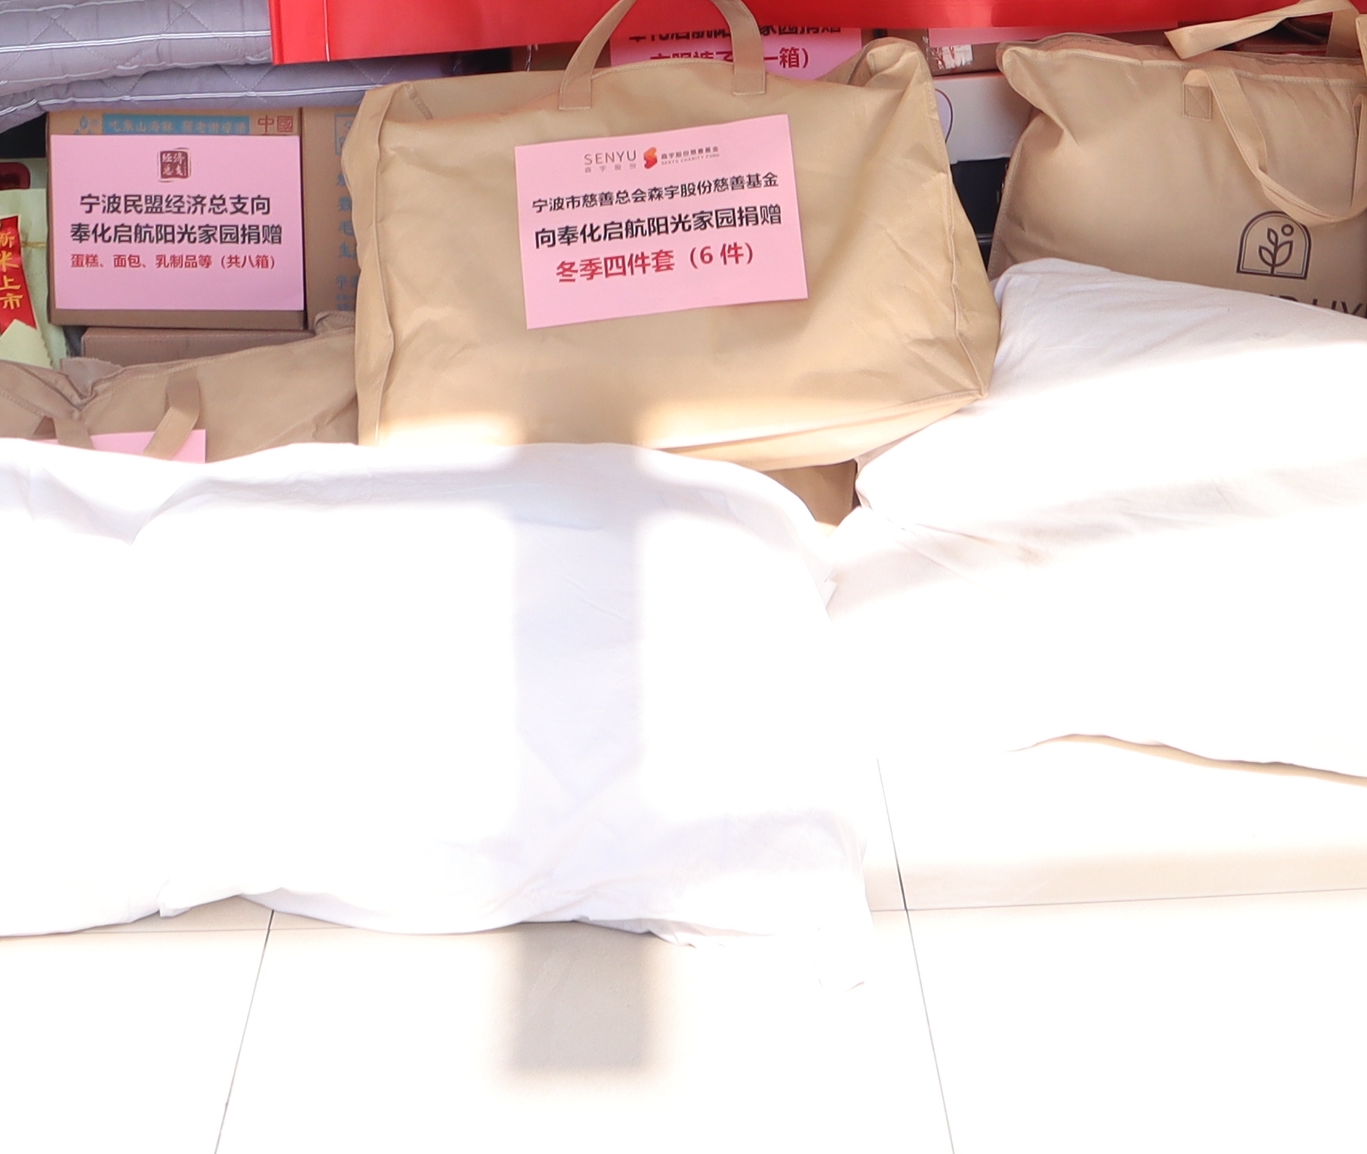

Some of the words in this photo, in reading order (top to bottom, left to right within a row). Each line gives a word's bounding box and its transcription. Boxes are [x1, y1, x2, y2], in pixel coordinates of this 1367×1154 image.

[584, 150, 637, 166] SENYU
[532, 172, 779, 214] 宁波市慈善总会森宇股份慈善基金
[80, 194, 271, 216] 宁波民盟经济总支向
[70, 223, 283, 246] 奉化启航阳光家园捐赠
[534, 204, 783, 248] 向奉化启航阳光家园捐赠
[70, 254, 277, 270] 蛋糕、面包、乳制品等（共八箱）
